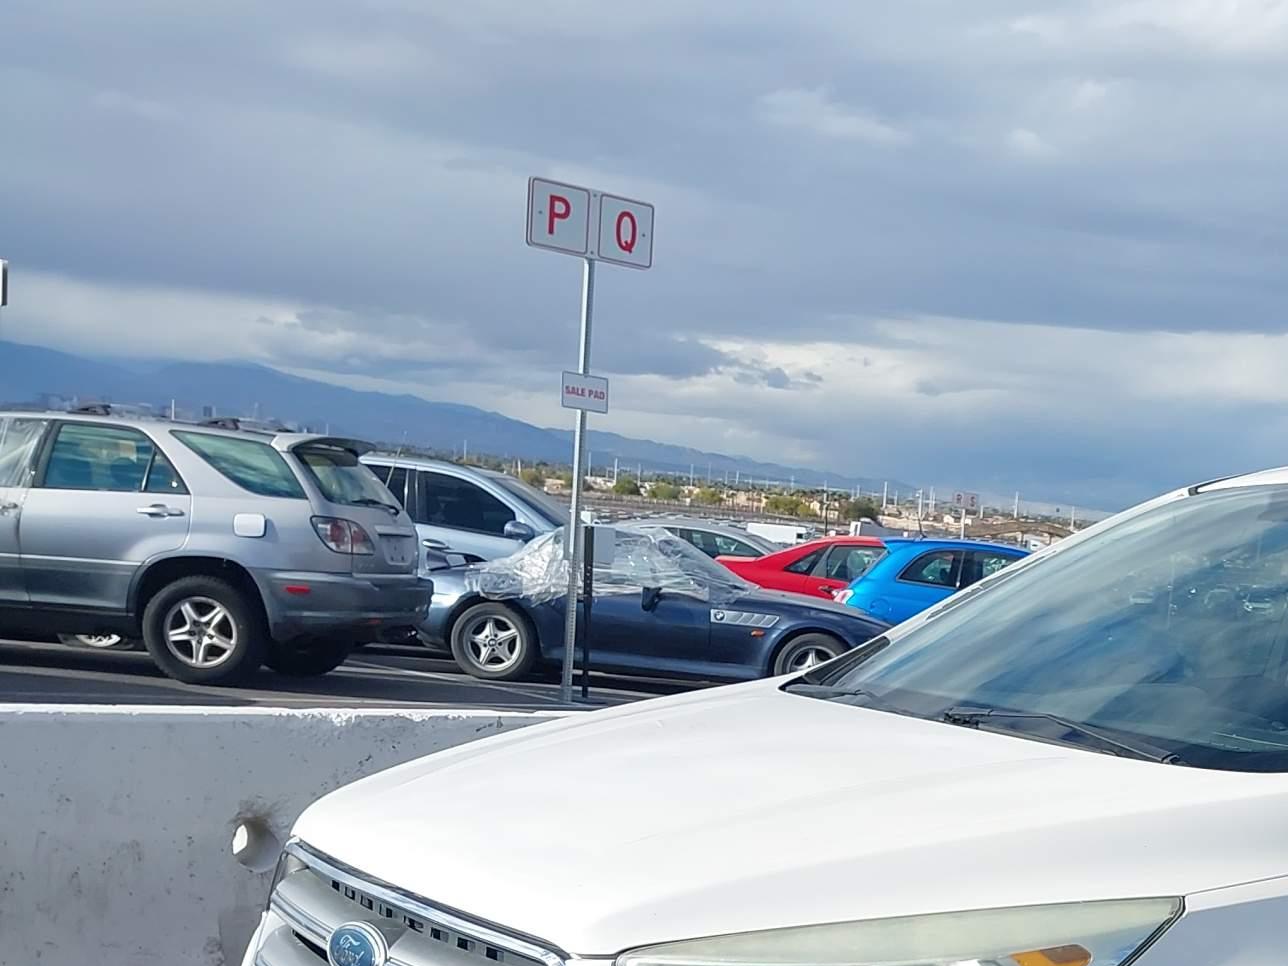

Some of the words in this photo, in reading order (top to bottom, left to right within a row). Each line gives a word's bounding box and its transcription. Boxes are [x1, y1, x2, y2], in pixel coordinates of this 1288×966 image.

[548, 194, 571, 235] P
[616, 211, 637, 253] Q
[565, 385, 586, 398] SALE
[588, 389, 605, 401] PAD
